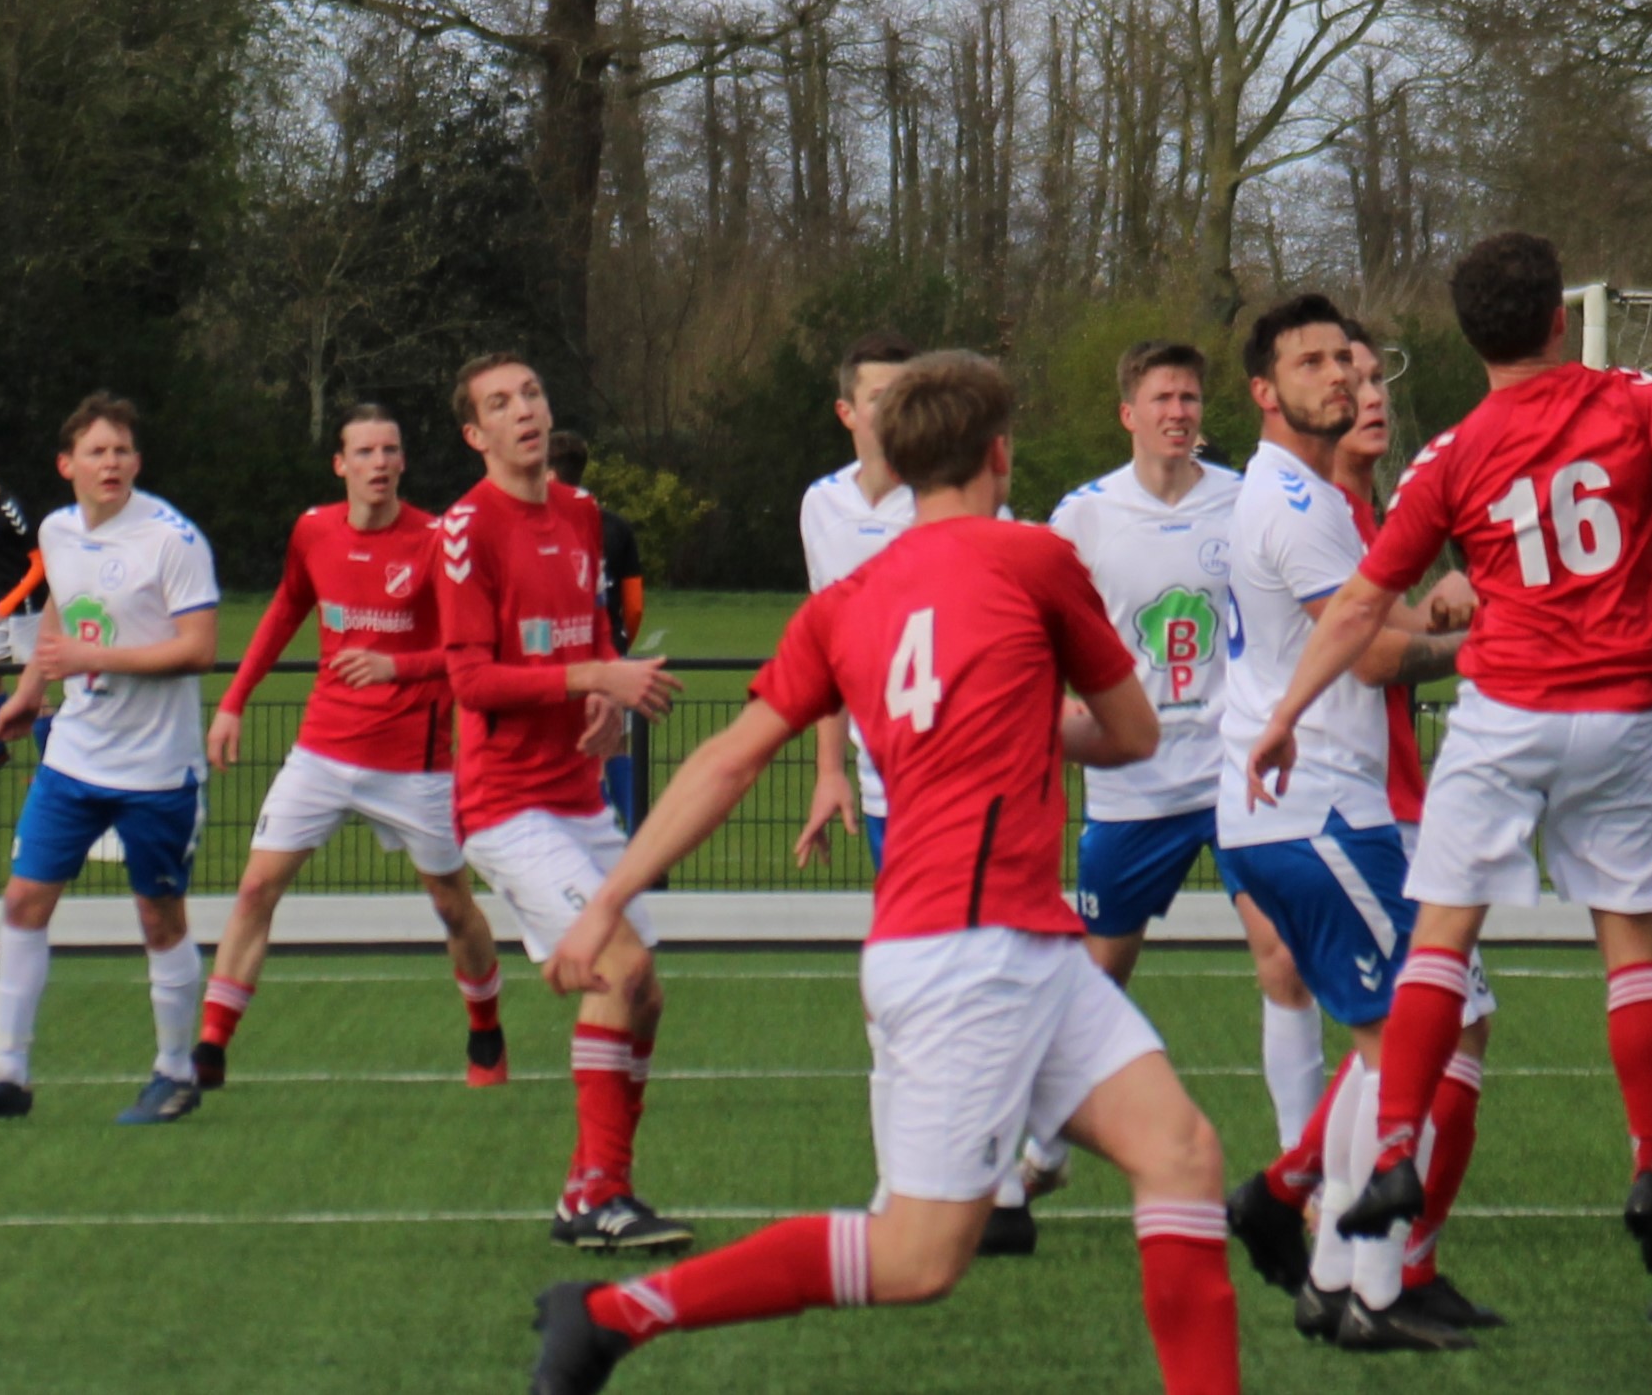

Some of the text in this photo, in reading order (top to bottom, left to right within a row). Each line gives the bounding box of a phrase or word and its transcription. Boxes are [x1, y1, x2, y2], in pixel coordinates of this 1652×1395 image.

[1488, 460, 1622, 587] 16
[1167, 619, 1198, 664] B
[884, 605, 943, 733] 4
[1171, 665, 1193, 703] P
[563, 885, 587, 911] 5
[1080, 890, 1099, 919] 13
